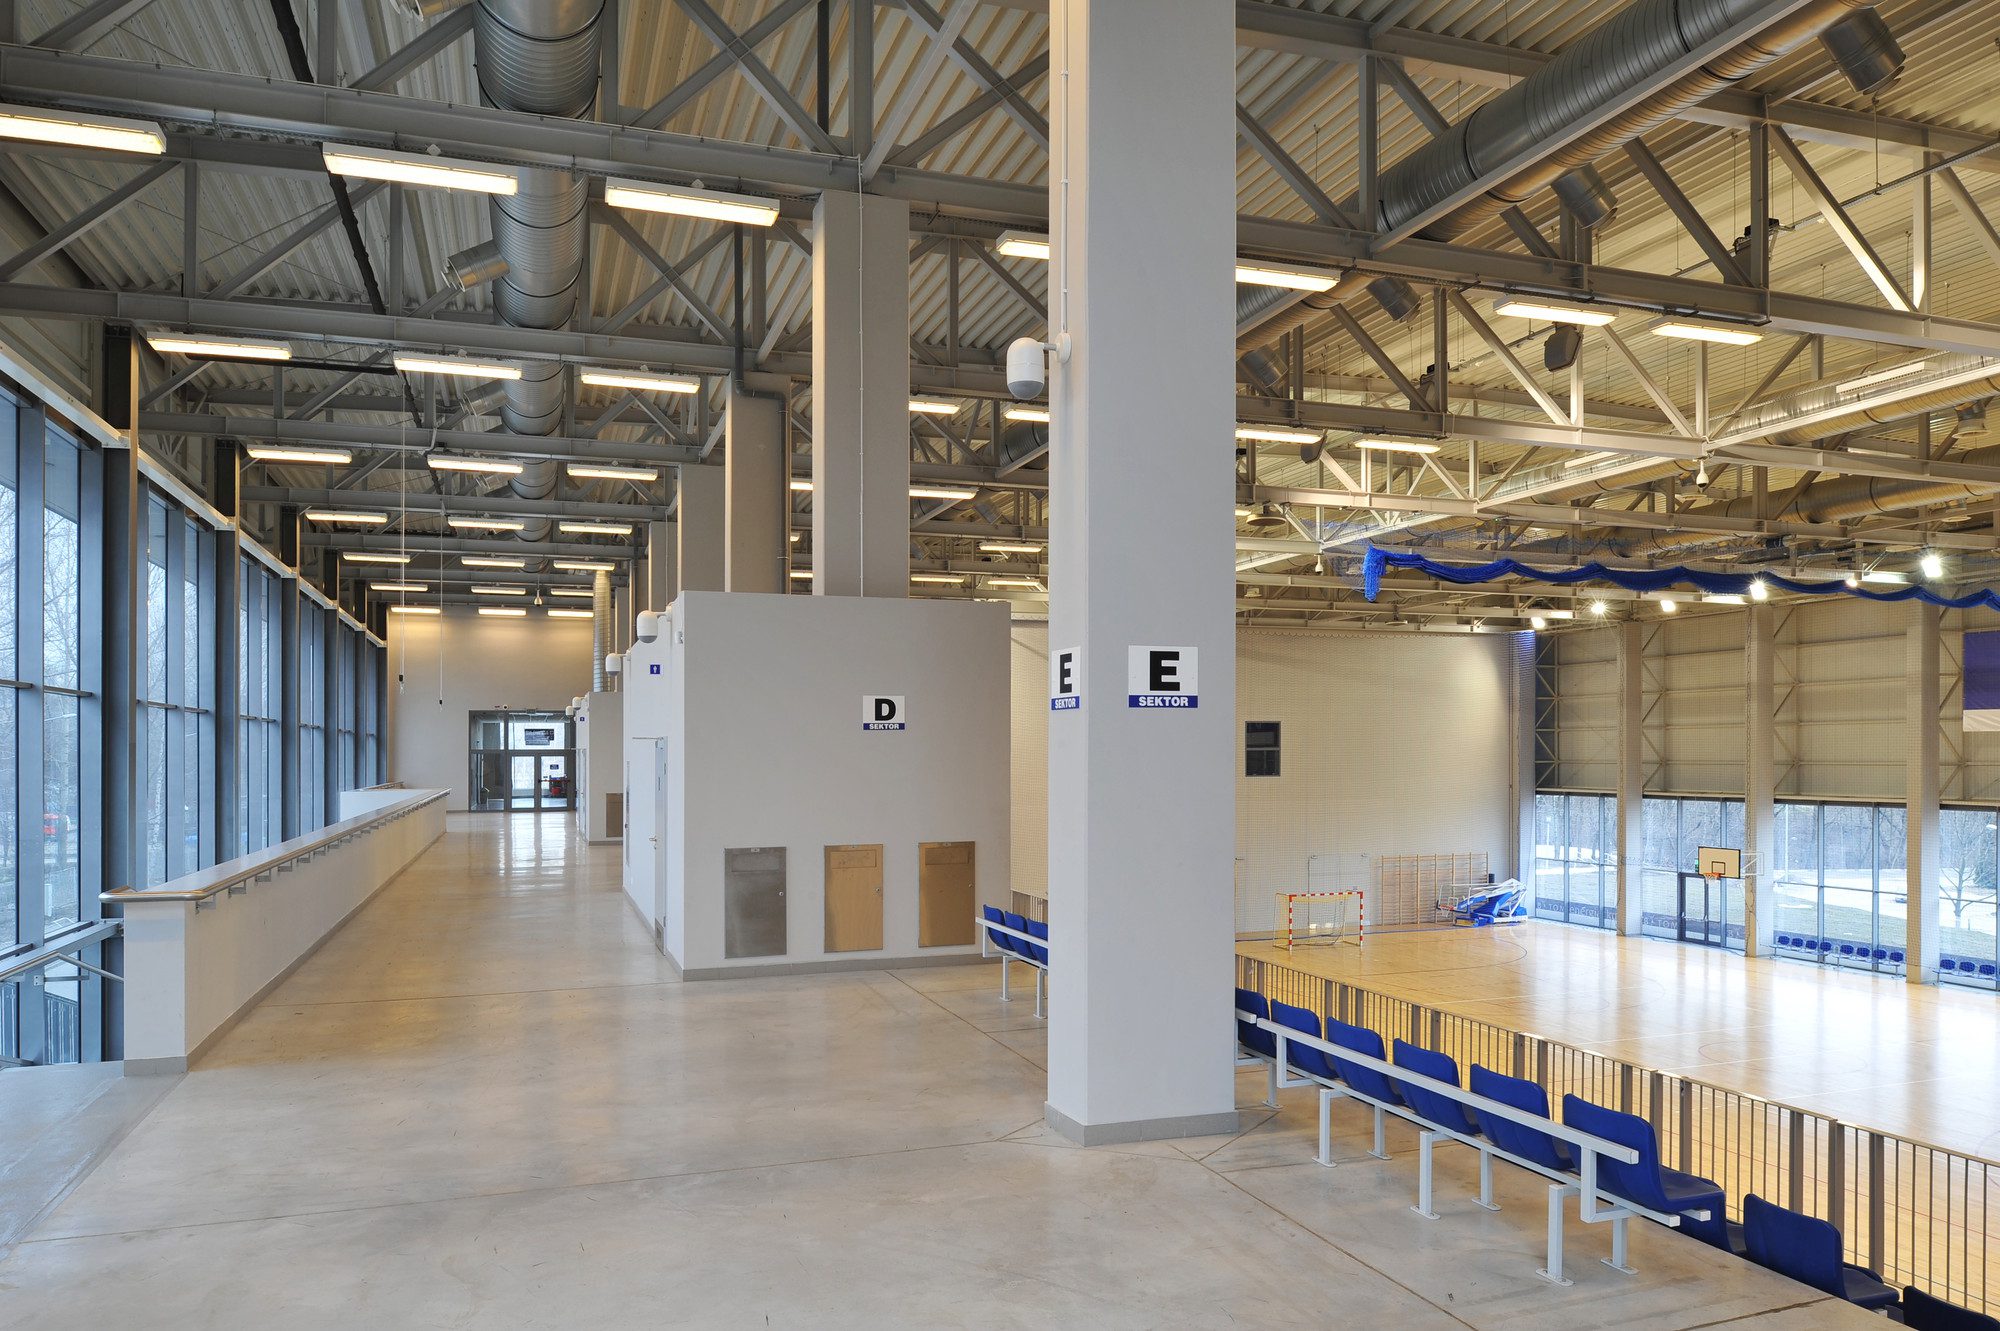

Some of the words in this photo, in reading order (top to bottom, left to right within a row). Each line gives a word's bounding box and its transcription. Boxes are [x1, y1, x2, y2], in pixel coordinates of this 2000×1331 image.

[1060, 652, 1072, 694] E
[1149, 651, 1180, 691] E
[875, 698, 896, 721] D
[1055, 697, 1076, 709] SEKTOR
[1138, 696, 1189, 707] SEKTOR
